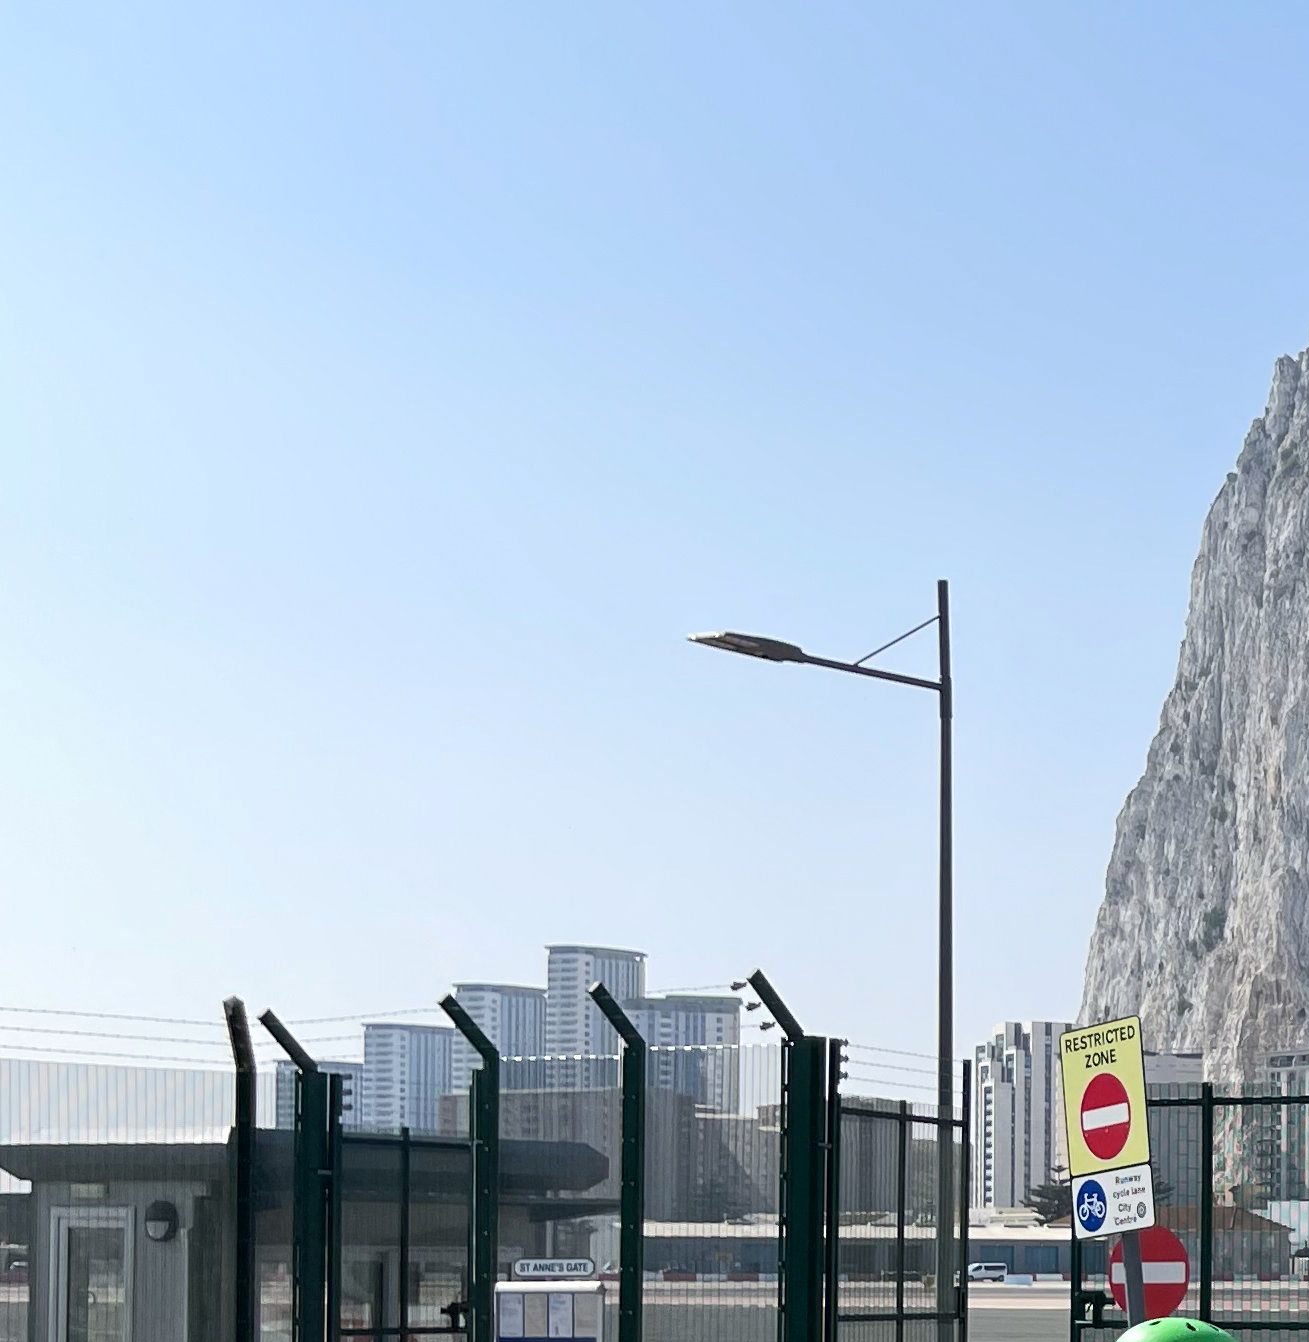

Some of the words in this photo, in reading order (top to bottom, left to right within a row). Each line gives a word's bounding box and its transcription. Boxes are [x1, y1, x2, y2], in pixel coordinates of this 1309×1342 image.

[1064, 1025, 1135, 1054] RESTRICTED
[1084, 1048, 1117, 1069] ZONE
[1115, 1174, 1141, 1185] Runway
[1112, 1188, 1130, 1200] cycle
[1131, 1186, 1146, 1195] lane
[1118, 1202, 1131, 1213] City
[1114, 1215, 1137, 1226] Centre
[519, 1262, 530, 1272] ST
[532, 1262, 564, 1273] ANNE'S
